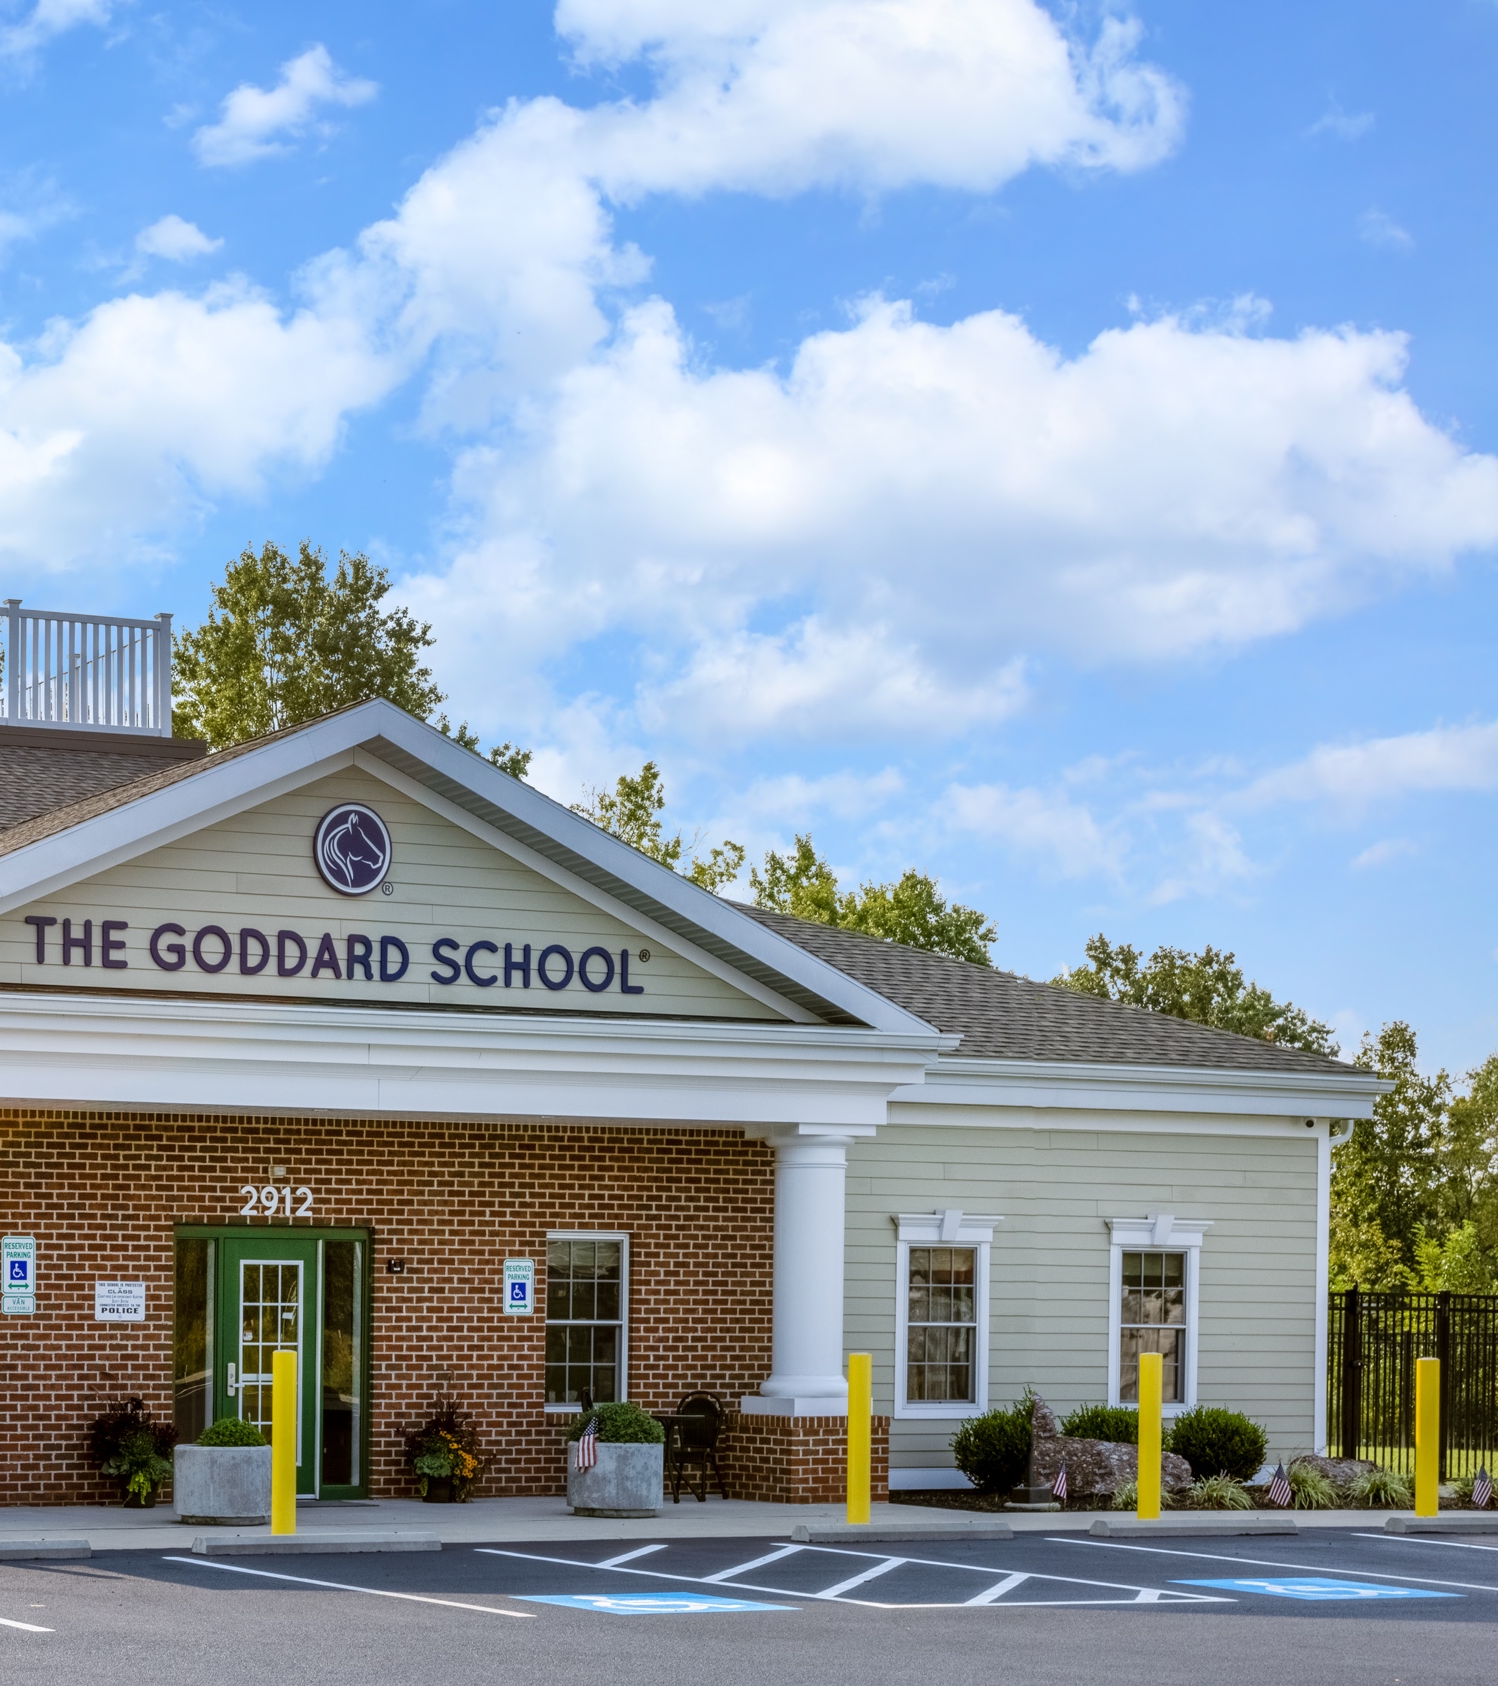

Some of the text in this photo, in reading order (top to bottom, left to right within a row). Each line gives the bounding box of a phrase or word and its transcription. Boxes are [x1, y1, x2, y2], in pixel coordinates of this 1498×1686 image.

[24, 915, 129, 969] THE
[149, 922, 411, 983] GODDARD
[240, 1185, 314, 1217] 2912
[4, 1242, 33, 1250] RESERVED
